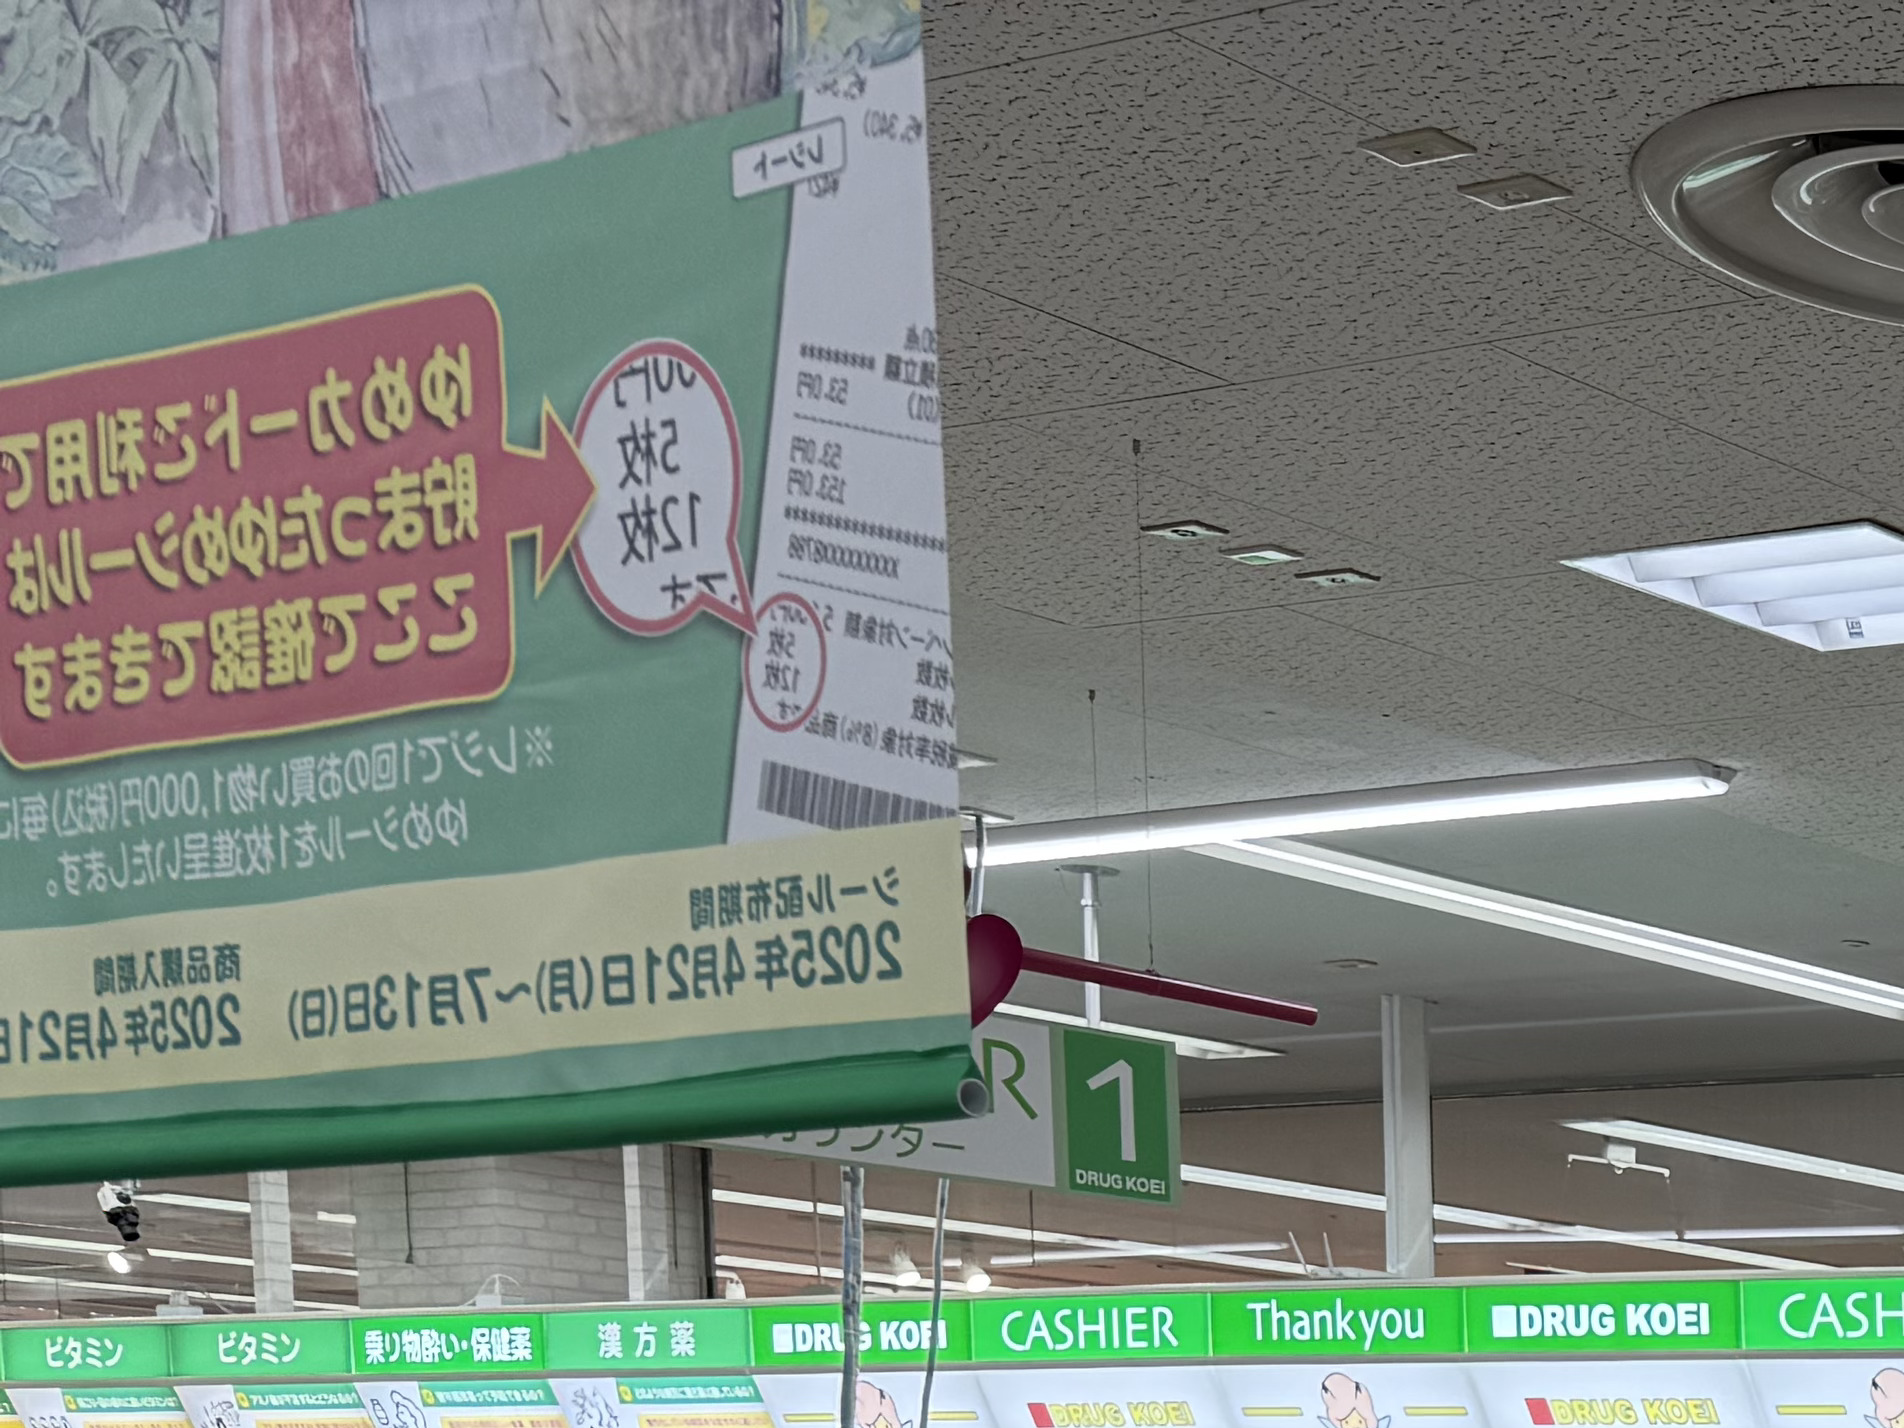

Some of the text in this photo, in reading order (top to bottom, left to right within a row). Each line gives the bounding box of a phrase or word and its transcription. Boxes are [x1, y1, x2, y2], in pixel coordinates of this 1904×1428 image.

[980, 1039, 1037, 1119] R
[1087, 1060, 1137, 1162] 1
[1075, 1168, 1167, 1195] DRUG KOEI
[597, 1320, 697, 1360] 漢方薬
[1000, 1305, 1179, 1353] CASHIER
[1246, 1298, 1426, 1352] Thank you
[1518, 1300, 1711, 1340] DRUG KOEI
[44, 1335, 124, 1369] ビタミン
[217, 1330, 302, 1366] ビタミン
[364, 1325, 533, 1365] 乗り物酔い・保健薬
[1126, 1400, 1197, 1428] KOEI
[1552, 1397, 1719, 1428] DRUG KOEI
